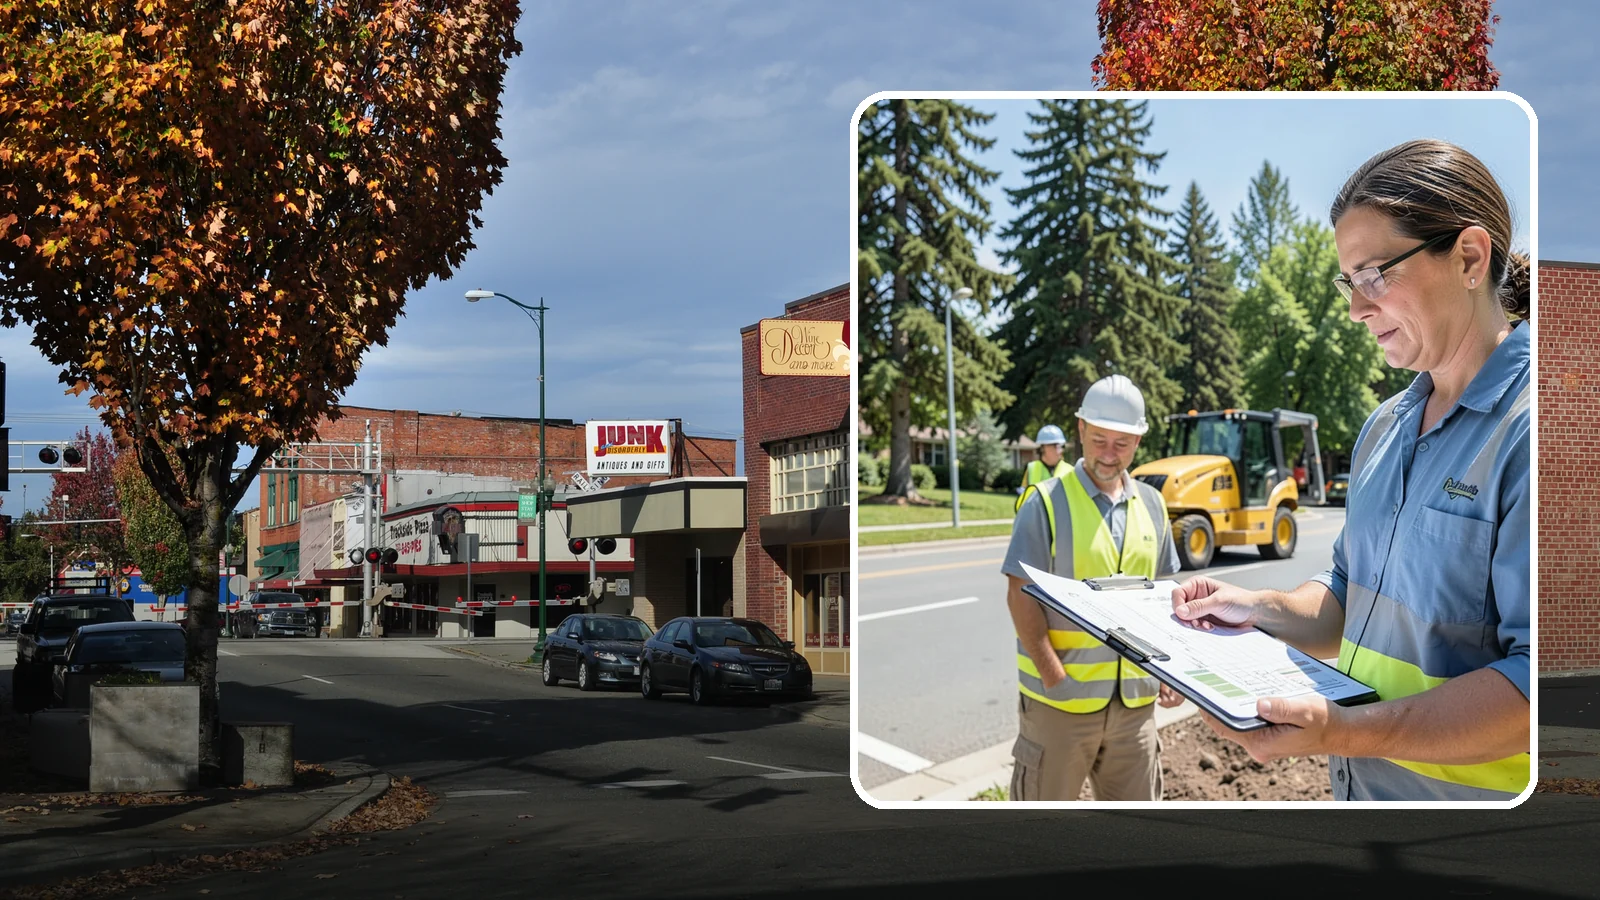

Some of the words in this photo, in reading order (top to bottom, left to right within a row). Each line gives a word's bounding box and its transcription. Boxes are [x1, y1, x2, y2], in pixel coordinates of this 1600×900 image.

[765, 328, 831, 365] Decor
[596, 425, 664, 457] JUNK
[607, 446, 646, 454] DISORDERLY
[597, 461, 628, 470] ANTIQUES
[631, 461, 644, 469] AND
[647, 461, 665, 469] GIFTS
[414, 519, 429, 535] Pizza
